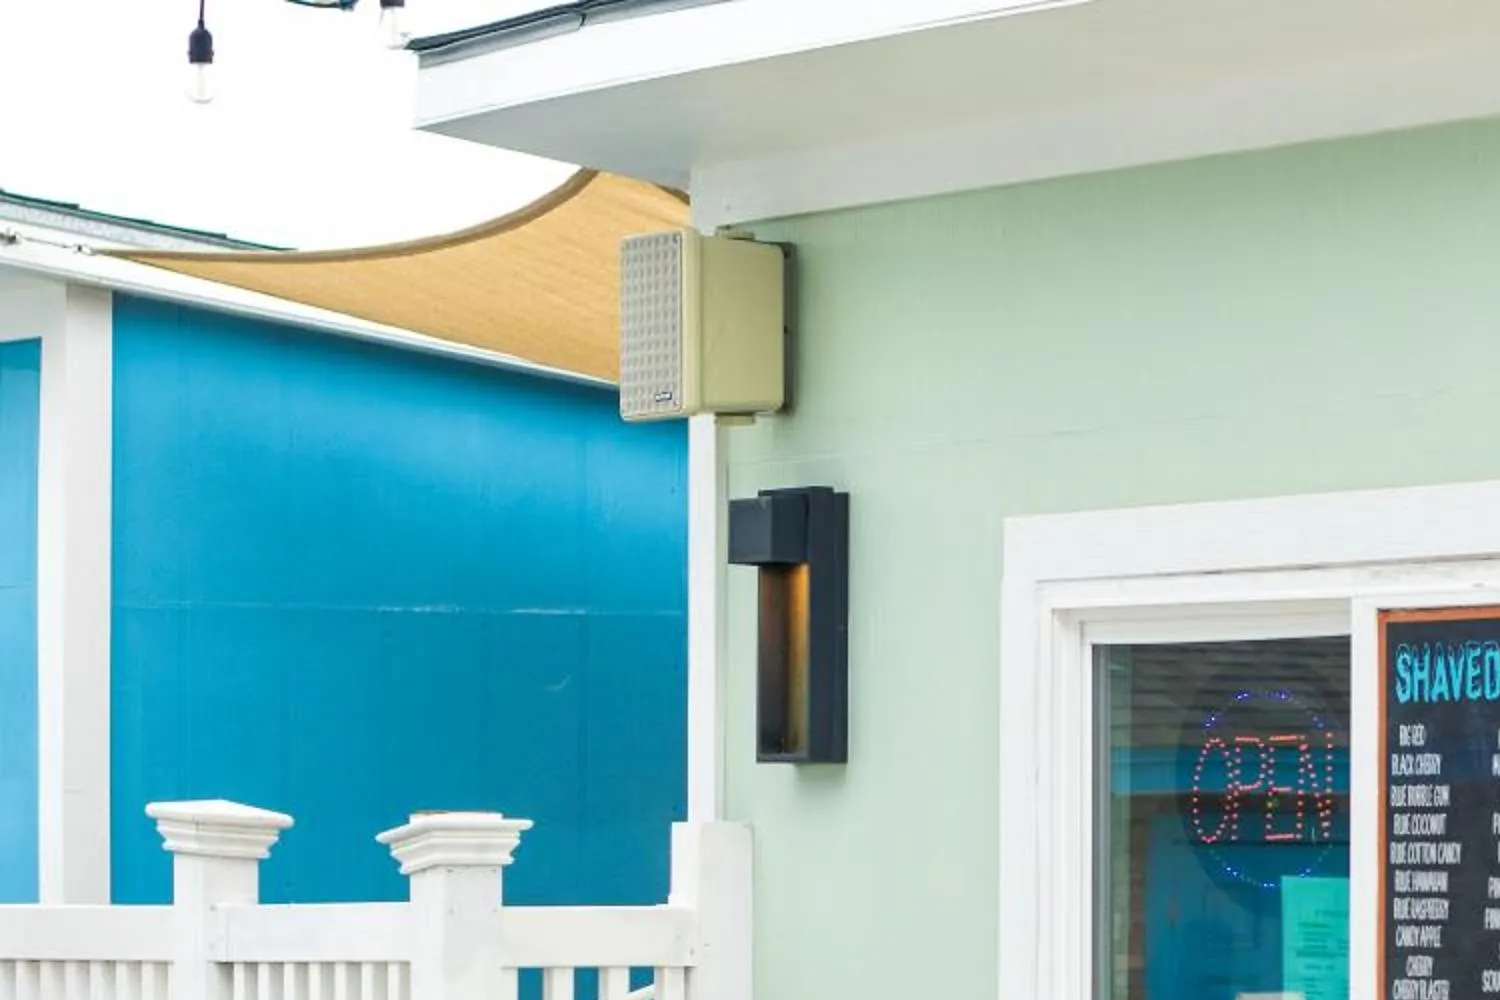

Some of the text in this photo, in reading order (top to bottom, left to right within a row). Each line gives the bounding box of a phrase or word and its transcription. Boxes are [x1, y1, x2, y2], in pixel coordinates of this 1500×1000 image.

[1391, 753, 1415, 776] BLACK
[1194, 732, 1332, 843] OPEN
[1393, 813, 1447, 835] BLUE COCONUT
[1389, 842, 1407, 865] BLUE
[1407, 842, 1437, 865] COTTON
